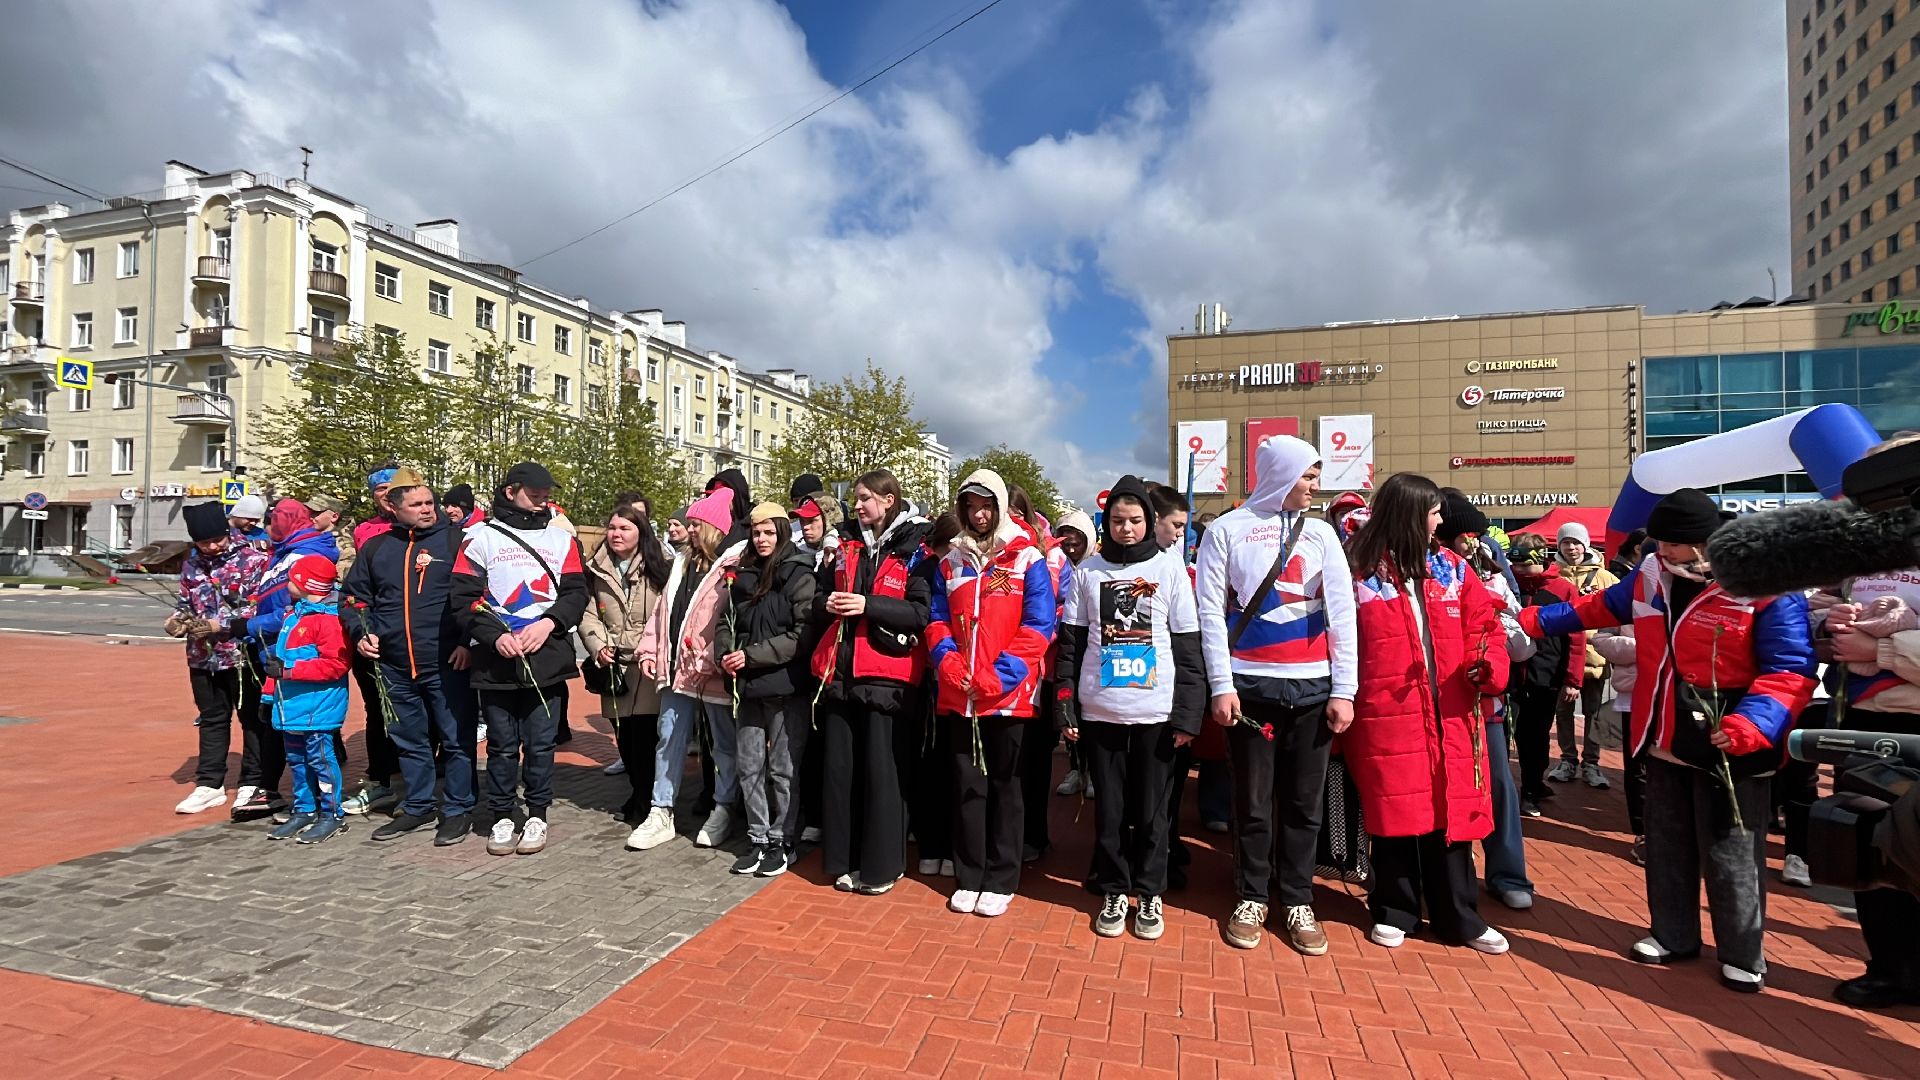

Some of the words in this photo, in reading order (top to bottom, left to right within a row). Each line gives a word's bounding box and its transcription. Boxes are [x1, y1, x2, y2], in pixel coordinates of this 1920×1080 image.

[1485, 357, 1559, 371] ГАЗПРОМБАНК
[1183, 373, 1225, 382] ТЕАТР
[1239, 362, 1295, 386] PRADA
[1336, 364, 1384, 376] КИНО
[1478, 419, 1508, 428] ПИКО
[1510, 419, 1548, 428] ПИЦЦА
[1188, 436, 1203, 455] 9
[1331, 431, 1347, 452] 9
[1499, 493, 1531, 505] СТАР
[1533, 493, 1579, 505] ЛАУНЖ
[1722, 498, 1780, 513] DNS
[1111, 658, 1147, 677] 130
